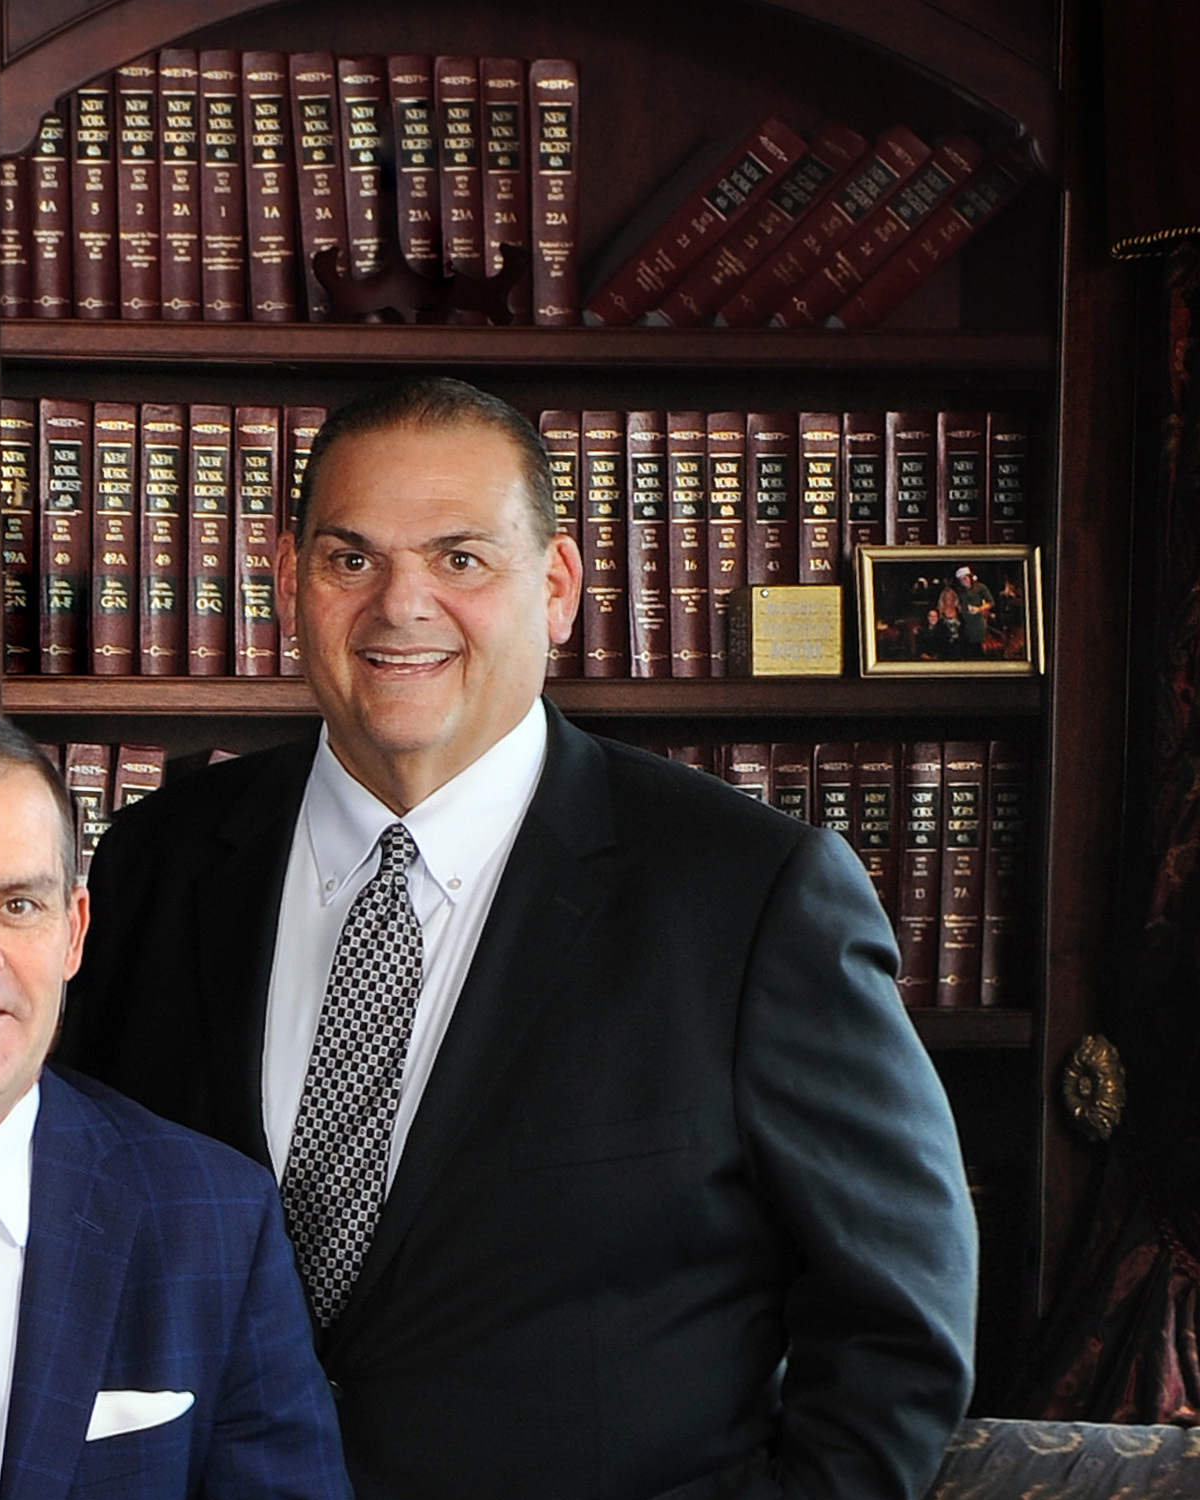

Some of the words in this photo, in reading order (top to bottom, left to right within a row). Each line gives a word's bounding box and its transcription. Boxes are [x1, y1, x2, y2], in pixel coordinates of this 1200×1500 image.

[81, 99, 104, 112] NEW
[126, 100, 149, 112] NEW
[168, 100, 191, 112] NEW
[210, 102, 232, 115] NEW
[255, 103, 278, 116] NEW
[304, 105, 327, 118] NEW
[351, 106, 375, 119] NEW
[405, 108, 427, 120] NEW
[448, 107, 470, 119] NEW
[492, 111, 514, 122] NEW
[544, 111, 567, 124] NEW
[80, 115, 106, 127] YORK
[125, 115, 150, 127] YORK
[166, 116, 193, 128] YORK
[208, 118, 234, 130] YORK
[254, 118, 280, 131] YORK
[304, 120, 330, 133] YORK
[40, 127, 64, 140] GEST
[351, 121, 378, 135] YORK
[404, 123, 430, 135] YORK
[447, 123, 472, 134] YORK
[490, 126, 516, 137] YORK
[543, 127, 569, 139] YORK
[77, 130, 109, 142] DIGEST
[122, 130, 154, 142] DIGEST
[164, 131, 196, 143] DIGEST
[206, 133, 237, 145] DIGEST
[252, 134, 284, 146] DIGEST
[302, 135, 334, 148] DIGEST
[349, 137, 381, 150] DIGEST
[402, 138, 432, 150] DIGEST
[444, 138, 475, 150] DIGEST
[488, 141, 520, 153] DIGEST
[540, 141, 572, 154] DIGEST
[738, 160, 763, 183] NEW
[728, 169, 754, 195] YORK
[716, 177, 747, 206] DIGEST
[844, 181, 874, 210] DIGEST
[5, 199, 14, 211] 3
[40, 199, 57, 212] 4A
[899, 187, 930, 216] DIGEST
[91, 202, 99, 215] 5
[136, 203, 144, 215] 2
[172, 202, 191, 216] 2A
[220, 205, 226, 217] 1
[263, 206, 280, 219] 1A
[315, 207, 332, 220] 3A
[365, 208, 373, 221] 4
[451, 208, 474, 221] 23A
[408, 209, 431, 222] 23A
[545, 212, 568, 225] 22A
[2, 450, 26, 462] NEW
[55, 450, 77, 461] NEW
[104, 452, 127, 464] NEW
[150, 454, 174, 465] NEW
[200, 455, 222, 467] NEW
[245, 456, 268, 468] NEW
[593, 461, 615, 472] NEW
[637, 462, 659, 474] NEW
[677, 461, 698, 473] NEW
[715, 462, 738, 474] NEW
[809, 462, 832, 474] NEW
[902, 462, 923, 472] NEW
[953, 461, 974, 471] NEW
[1, 466, 27, 478] YORK
[54, 465, 79, 477] YORK
[102, 467, 128, 479] YORK
[149, 468, 175, 480] YORK
[761, 463, 782, 474] NEW
[854, 464, 874, 474] NEW
[197, 470, 223, 482] YORK
[244, 471, 269, 482] YORK
[552, 476, 573, 487] ORK
[591, 475, 616, 487] YORK
[675, 476, 699, 487] YORK
[807, 476, 833, 488] YORK
[901, 476, 924, 486] YORK
[952, 475, 975, 485] YORK
[50, 479, 82, 492] DIGEST
[99, 482, 132, 494] DIGEST
[636, 477, 660, 488] YORK
[714, 477, 740, 488] YORK
[760, 477, 784, 488] YORK
[852, 478, 875, 488] YORK
[146, 483, 179, 496] DIGEST
[194, 485, 227, 496] DIGEST
[241, 486, 272, 497] DIGEST
[553, 490, 576, 501] GEST
[588, 490, 620, 501] DIGEST
[898, 490, 927, 501] DIGEST
[949, 489, 978, 500] DIGEST
[634, 492, 663, 503] DIGEST
[673, 491, 704, 502] DIGEST
[711, 492, 742, 503] DIGEST
[757, 492, 787, 503] DIGEST
[804, 491, 836, 502] DIGEST
[54, 552, 71, 565] 49
[103, 552, 128, 566] 49A
[155, 554, 171, 566] 49
[202, 554, 218, 567] 50
[594, 558, 616, 571] 16A
[684, 559, 697, 572] 16
[720, 559, 735, 572] 27
[810, 559, 832, 571] 15A
[825, 792, 846, 803] NEW
[865, 793, 885, 803] NEW
[912, 792, 933, 803] NEW
[953, 792, 974, 803] NEW
[825, 806, 847, 817] YORK
[865, 807, 886, 817] YORK
[912, 806, 934, 818] YORK
[951, 806, 974, 816] YORK
[821, 821, 849, 831] DIGEST
[861, 821, 889, 831] DIGEST
[907, 820, 936, 831] DIGEST
[948, 820, 979, 830] DIGEST
[953, 887, 970, 899] 7A
